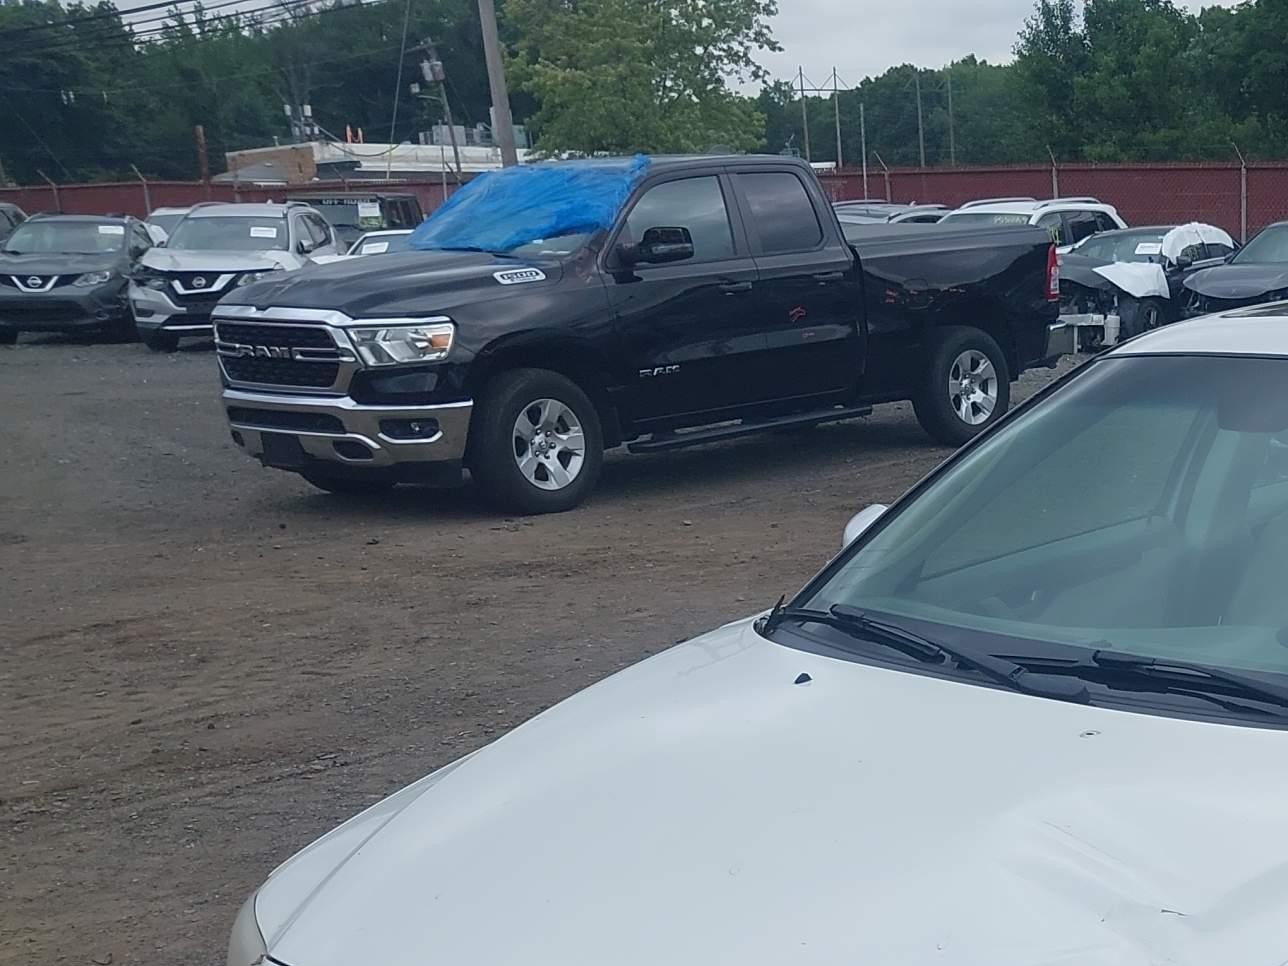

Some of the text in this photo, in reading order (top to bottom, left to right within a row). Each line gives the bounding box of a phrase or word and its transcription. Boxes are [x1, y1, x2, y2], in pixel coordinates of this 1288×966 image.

[501, 270, 539, 281] 1500
[238, 344, 291, 359] RAM
[639, 364, 681, 378] RAM
